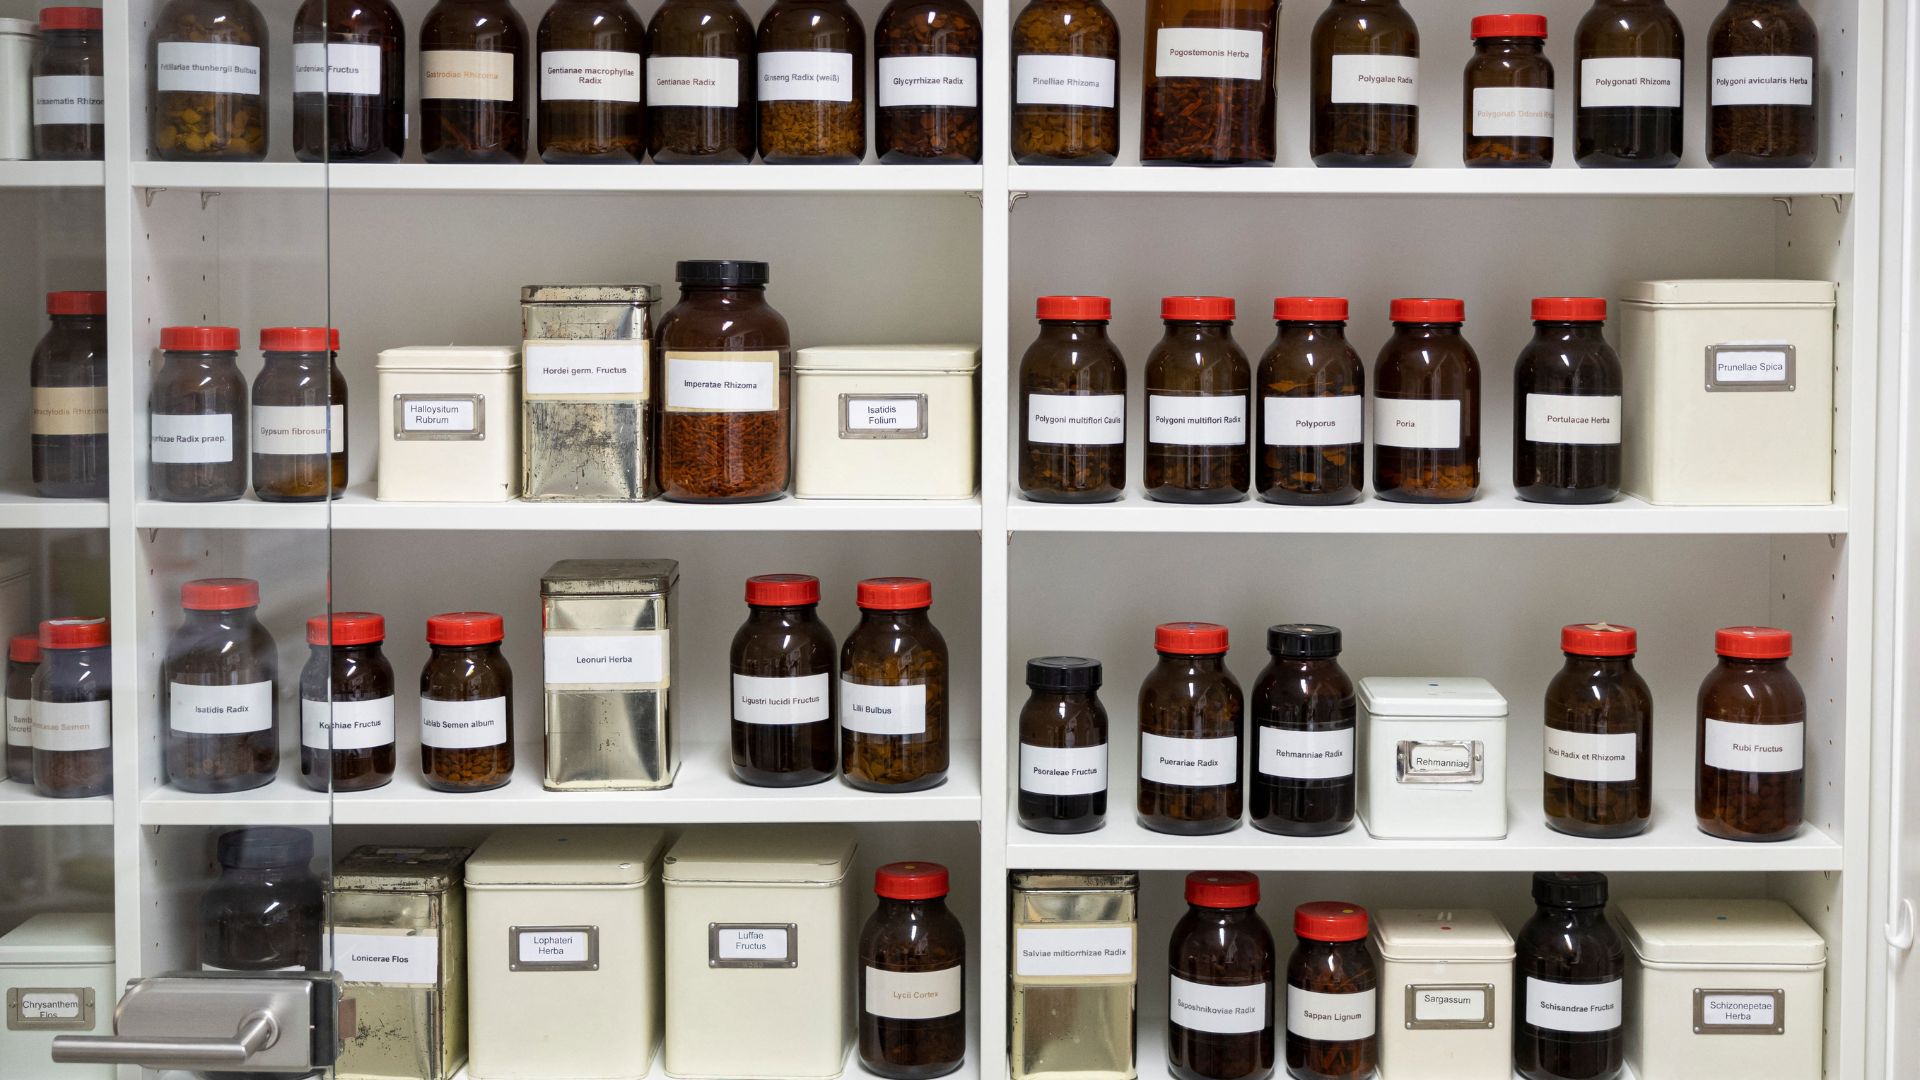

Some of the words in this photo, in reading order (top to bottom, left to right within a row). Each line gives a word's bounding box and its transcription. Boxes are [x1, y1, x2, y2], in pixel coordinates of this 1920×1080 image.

[1170, 48, 1225, 60] Pogostemonis
[1227, 49, 1249, 59] Herba
[234, 65, 256, 75] Bulbus
[328, 65, 359, 74] Fructus
[548, 66, 582, 75] Gentianae
[583, 68, 634, 79] macrophyllae
[579, 76, 602, 85] Radix
[657, 78, 690, 86] Gentianae
[693, 77, 715, 87] Radix
[792, 73, 814, 81] Radix
[893, 76, 940, 87] Glycyrrhizae
[943, 76, 963, 85] Radix
[1033, 77, 1064, 87] Pinelliae
[1067, 78, 1099, 88] Rhizoma
[1358, 74, 1395, 85] Polygalae
[1596, 77, 1637, 88] Polygonati
[1640, 77, 1670, 86] Rhizoma
[1717, 77, 1746, 88] Polygoni
[1748, 76, 1787, 85] avicularis
[1789, 76, 1807, 85] Herba
[543, 366, 569, 375] Hordei
[571, 368, 593, 377] germ.
[597, 366, 627, 374] Fructus
[1717, 363, 1757, 373] Prunellae
[1760, 362, 1782, 373] Spica
[685, 379, 721, 390] Imperatae
[724, 381, 757, 390] Rhizoma
[411, 404, 458, 418] Halloysitum
[868, 405, 896, 415] Isatidis
[416, 415, 448, 424] Rubrum
[869, 416, 896, 425] Folium
[1036, 414, 1066, 425] Polygoni
[1069, 416, 1102, 425] multiflori
[1156, 415, 1185, 426] Polygoni
[1188, 416, 1222, 425] multiflori
[1296, 419, 1335, 430] Polyporus
[1396, 419, 1415, 428] Poria
[1547, 414, 1589, 424] Portulacae
[1591, 416, 1610, 424] Herba
[261, 426, 289, 437] Gypsum
[177, 434, 199, 443] Radix
[577, 655, 606, 664] Leonuri
[609, 655, 632, 664] Herba
[742, 695, 766, 706] Ligustri
[769, 697, 790, 706] lucidi
[793, 696, 819, 705] Fructus
[196, 705, 224, 714] Isatidis
[227, 705, 248, 714] Radix
[866, 705, 891, 715] Bulbus
[354, 720, 381, 729] Fructus
[443, 720, 468, 729] Semen
[471, 719, 494, 728] album
[1276, 748, 1323, 759] Rehmanniae
[1325, 749, 1342, 759] Radix
[1733, 743, 1751, 752] Rubi
[1754, 744, 1783, 753] Fructus
[1561, 749, 1579, 760] Radix
[1582, 753, 1589, 761] et
[1592, 753, 1625, 762] Rhizoma
[1160, 756, 1195, 767] Puerariae
[1198, 759, 1218, 767] Radix
[1416, 756, 1470, 769] Rehmanniae
[1034, 766, 1069, 777] Psoraleae
[1072, 767, 1097, 776] Fructus
[736, 928, 765, 940] Luffae
[533, 936, 573, 948] Lophateri
[736, 941, 766, 951] Fructus
[539, 944, 564, 955] Herba
[1023, 949, 1051, 958] Salviae
[1104, 948, 1126, 957] Radix
[352, 954, 390, 963] Lonicerae
[392, 955, 408, 964] Flos
[1425, 994, 1471, 1005] Sargassum
[1235, 1005, 1255, 1015] Radix
[1540, 1000, 1591, 1013] Schisandrae
[1590, 1003, 1614, 1013] Fructus
[1710, 1000, 1771, 1013] Schizonepetae
[1304, 1009, 1332, 1021] Sappan
[1334, 1013, 1361, 1023] Lignum
[1726, 1009, 1751, 1021] Herba
